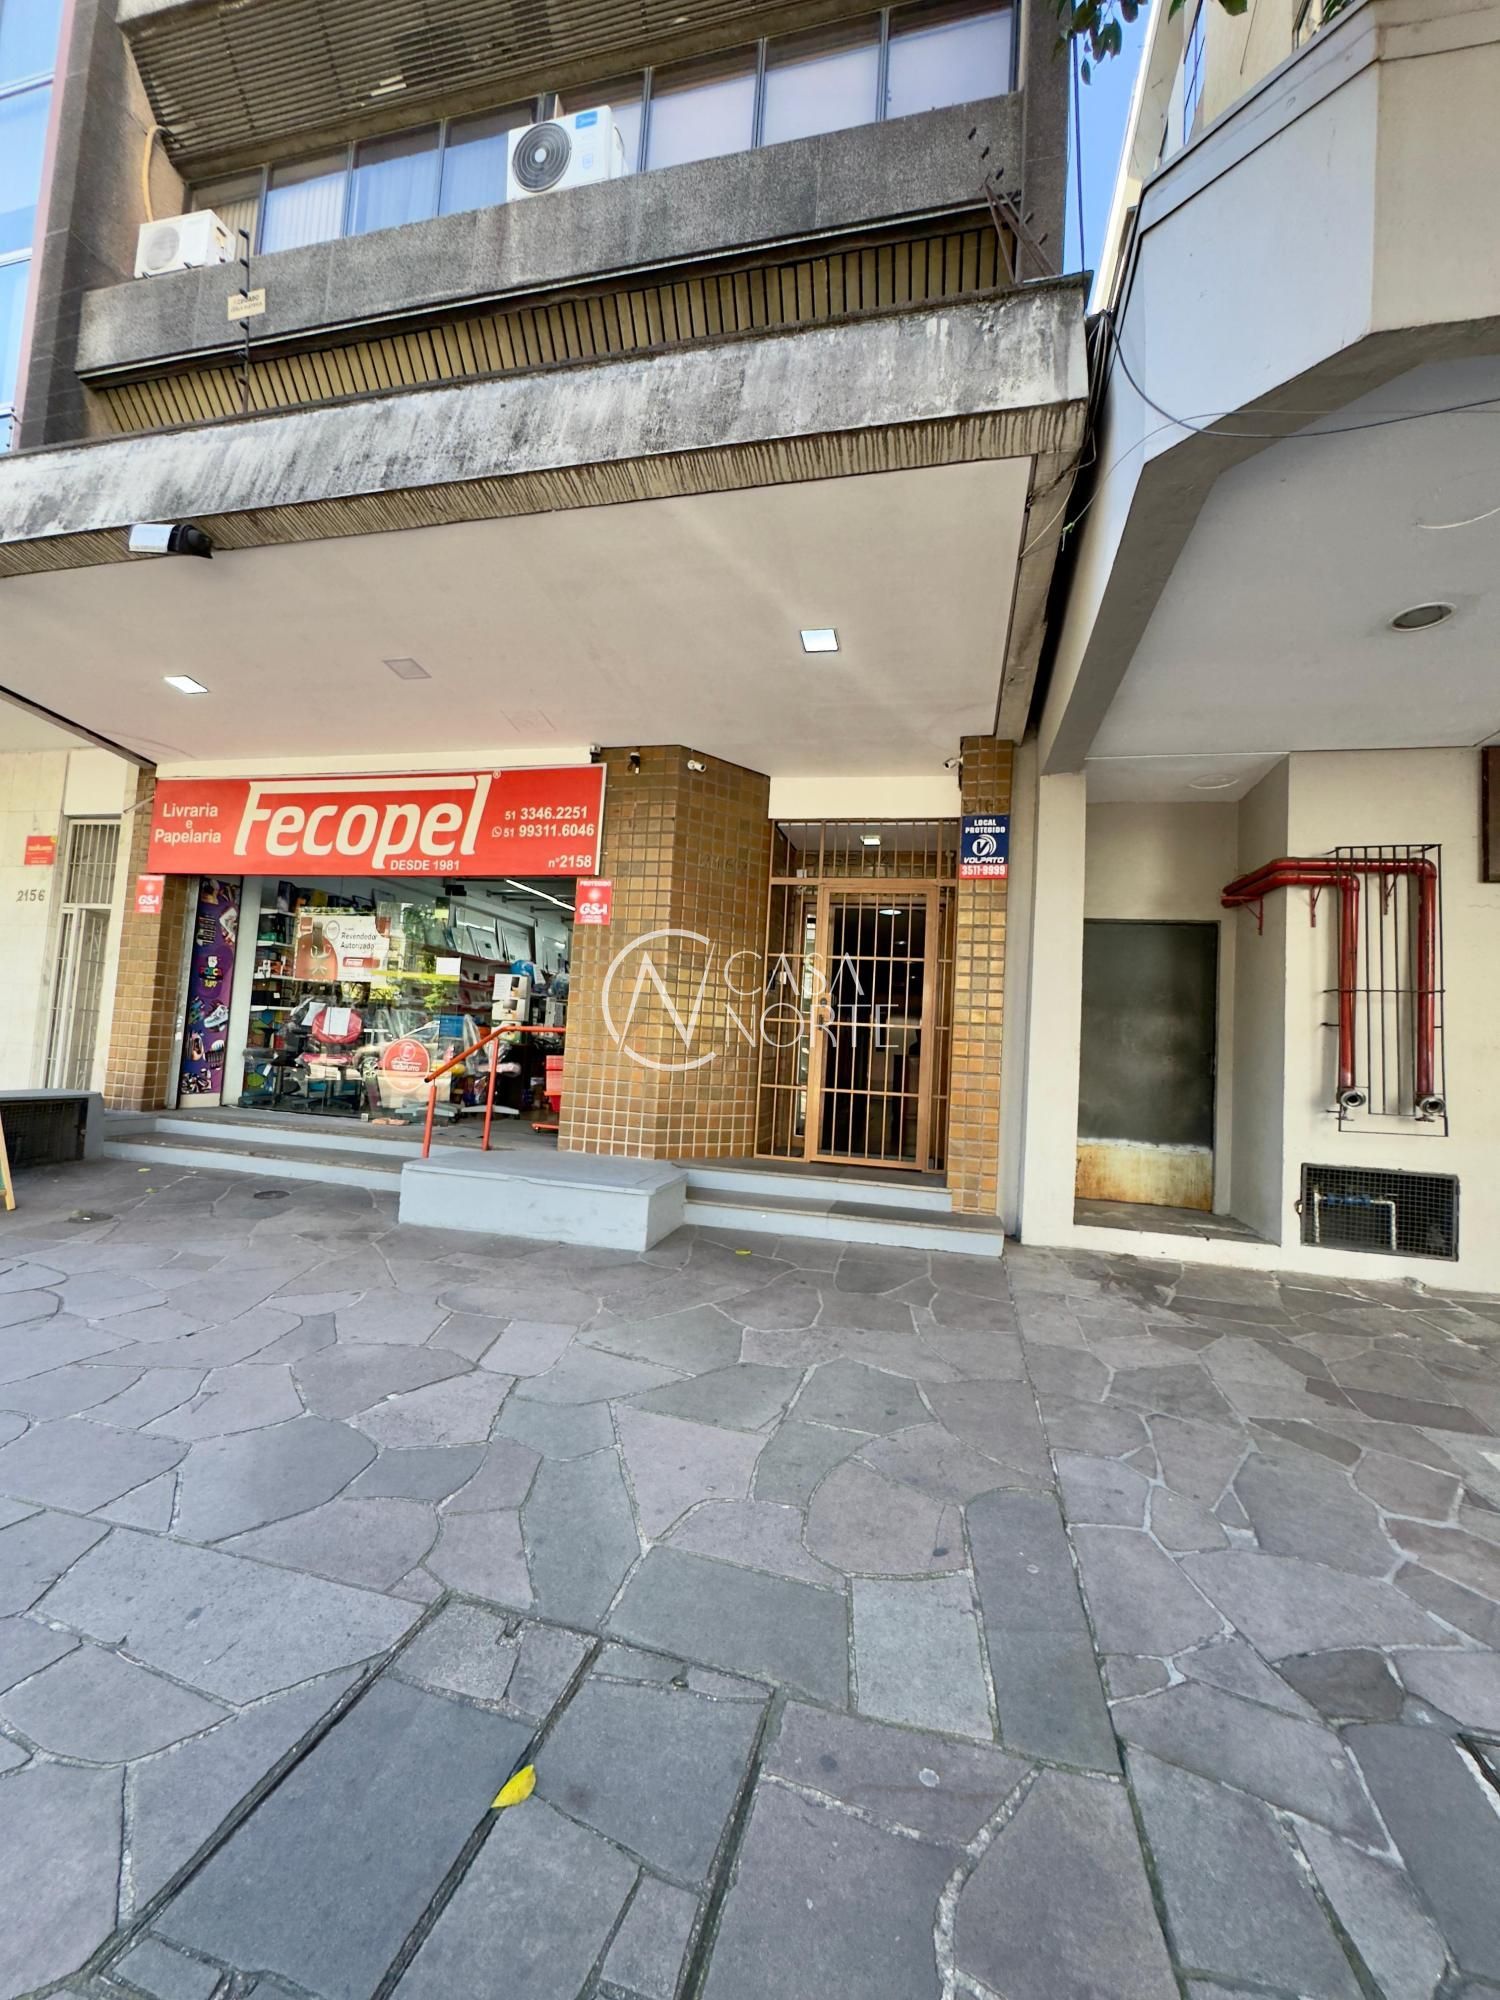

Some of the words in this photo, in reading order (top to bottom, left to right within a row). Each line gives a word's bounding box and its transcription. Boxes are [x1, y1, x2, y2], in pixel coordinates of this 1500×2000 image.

[162, 803, 219, 817] Livraria
[505, 811, 516, 820] 51
[520, 806, 588, 820] 3346.2251
[185, 819, 193, 829] e
[233, 774, 493, 870] Fecopel
[503, 829, 515, 838] 51
[518, 824, 595, 837] 99311.6046
[965, 826, 1006, 834] PROTEGIDO
[154, 828, 222, 846] Papelaria
[390, 860, 430, 870] DESDE
[433, 860, 460, 870] 1981
[961, 865, 1006, 876] 3511-9999
[16, 889, 46, 902] 2156
